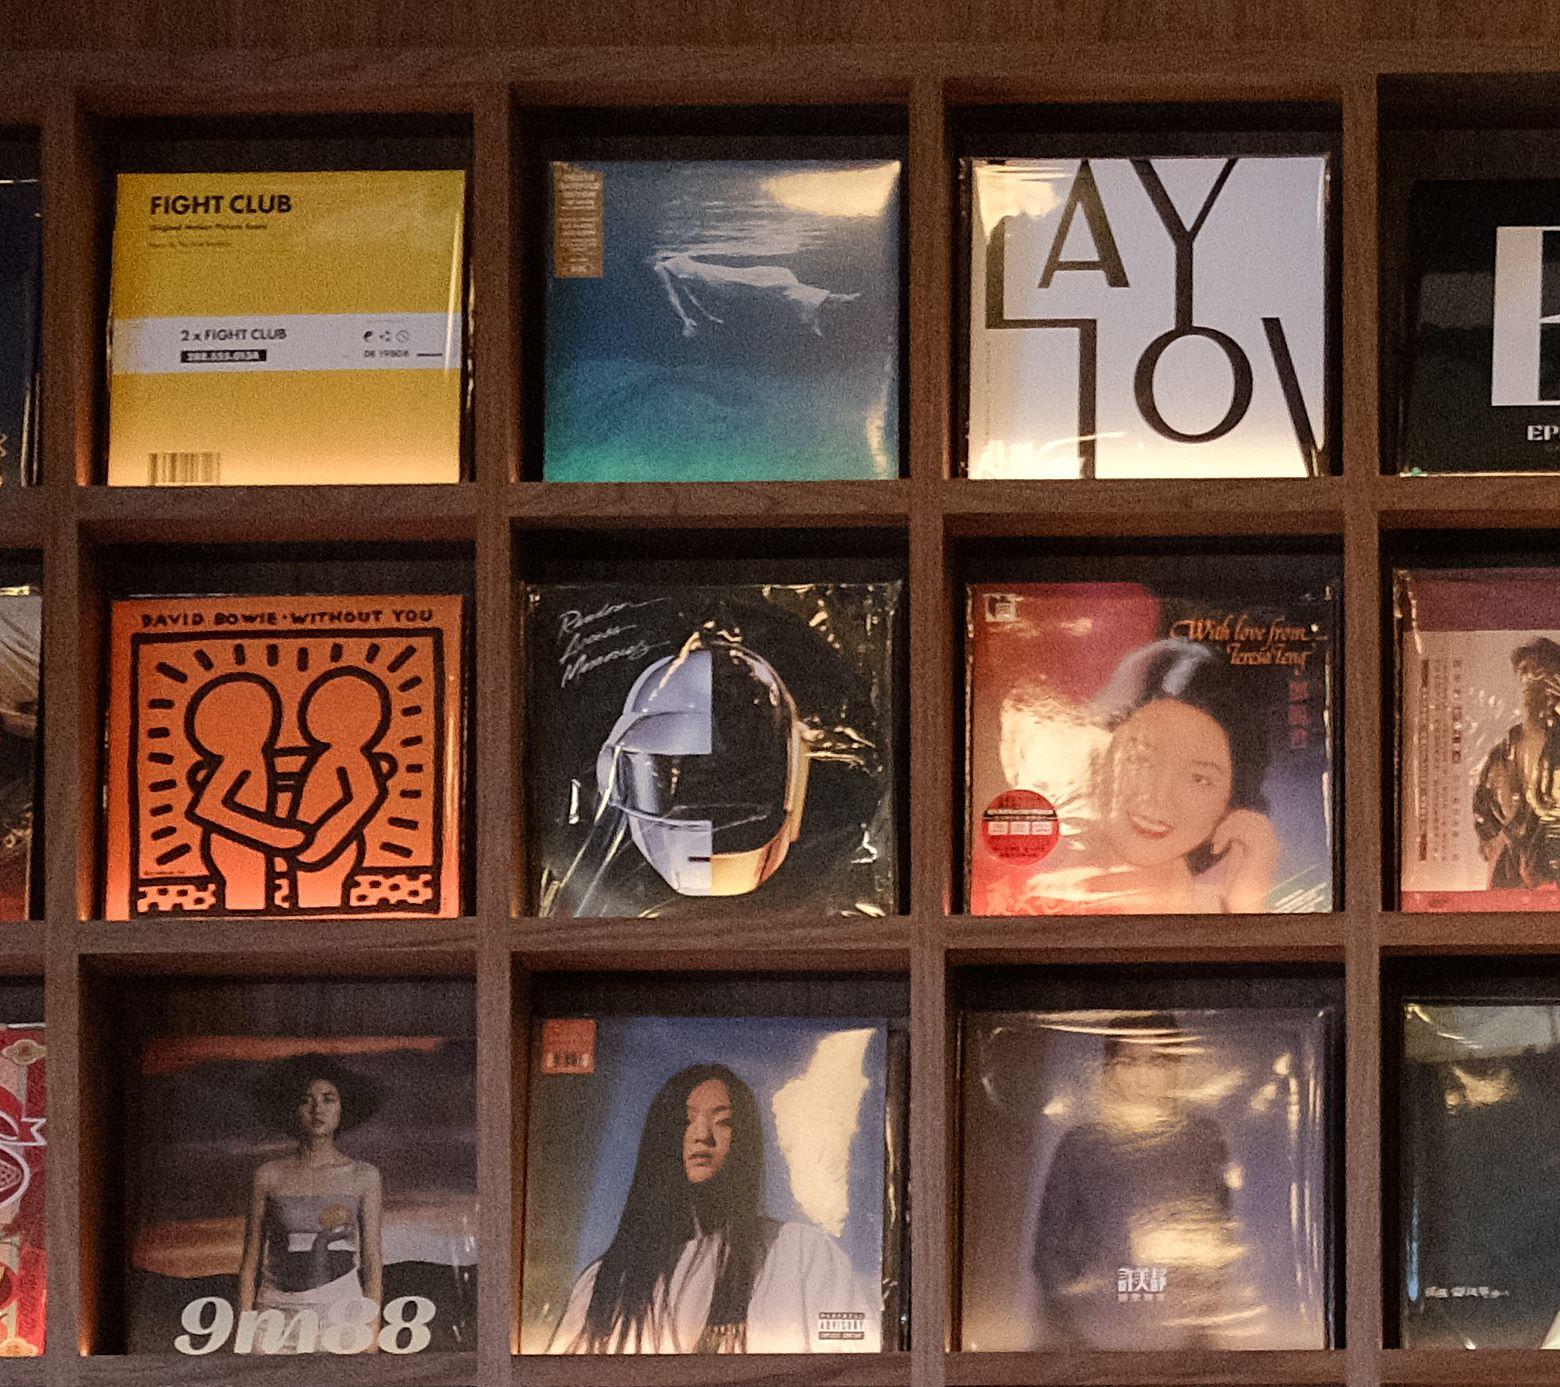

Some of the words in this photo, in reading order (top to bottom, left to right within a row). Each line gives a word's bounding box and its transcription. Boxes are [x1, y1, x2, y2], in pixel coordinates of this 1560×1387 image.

[151, 195, 220, 216] FIGHT
[228, 194, 293, 215] CLUB
[181, 331, 190, 342] 2
[204, 330, 243, 342] FIGHT
[247, 328, 287, 341] CLUB
[141, 613, 205, 628] DAVID
[213, 611, 279, 627] BOWIE
[290, 609, 383, 626] WITHOUT
[392, 608, 434, 624] YOU
[1172, 615, 1231, 642] With
[1235, 615, 1268, 641] love
[1269, 615, 1308, 650] from
[173, 1294, 437, 1356] 9m88
